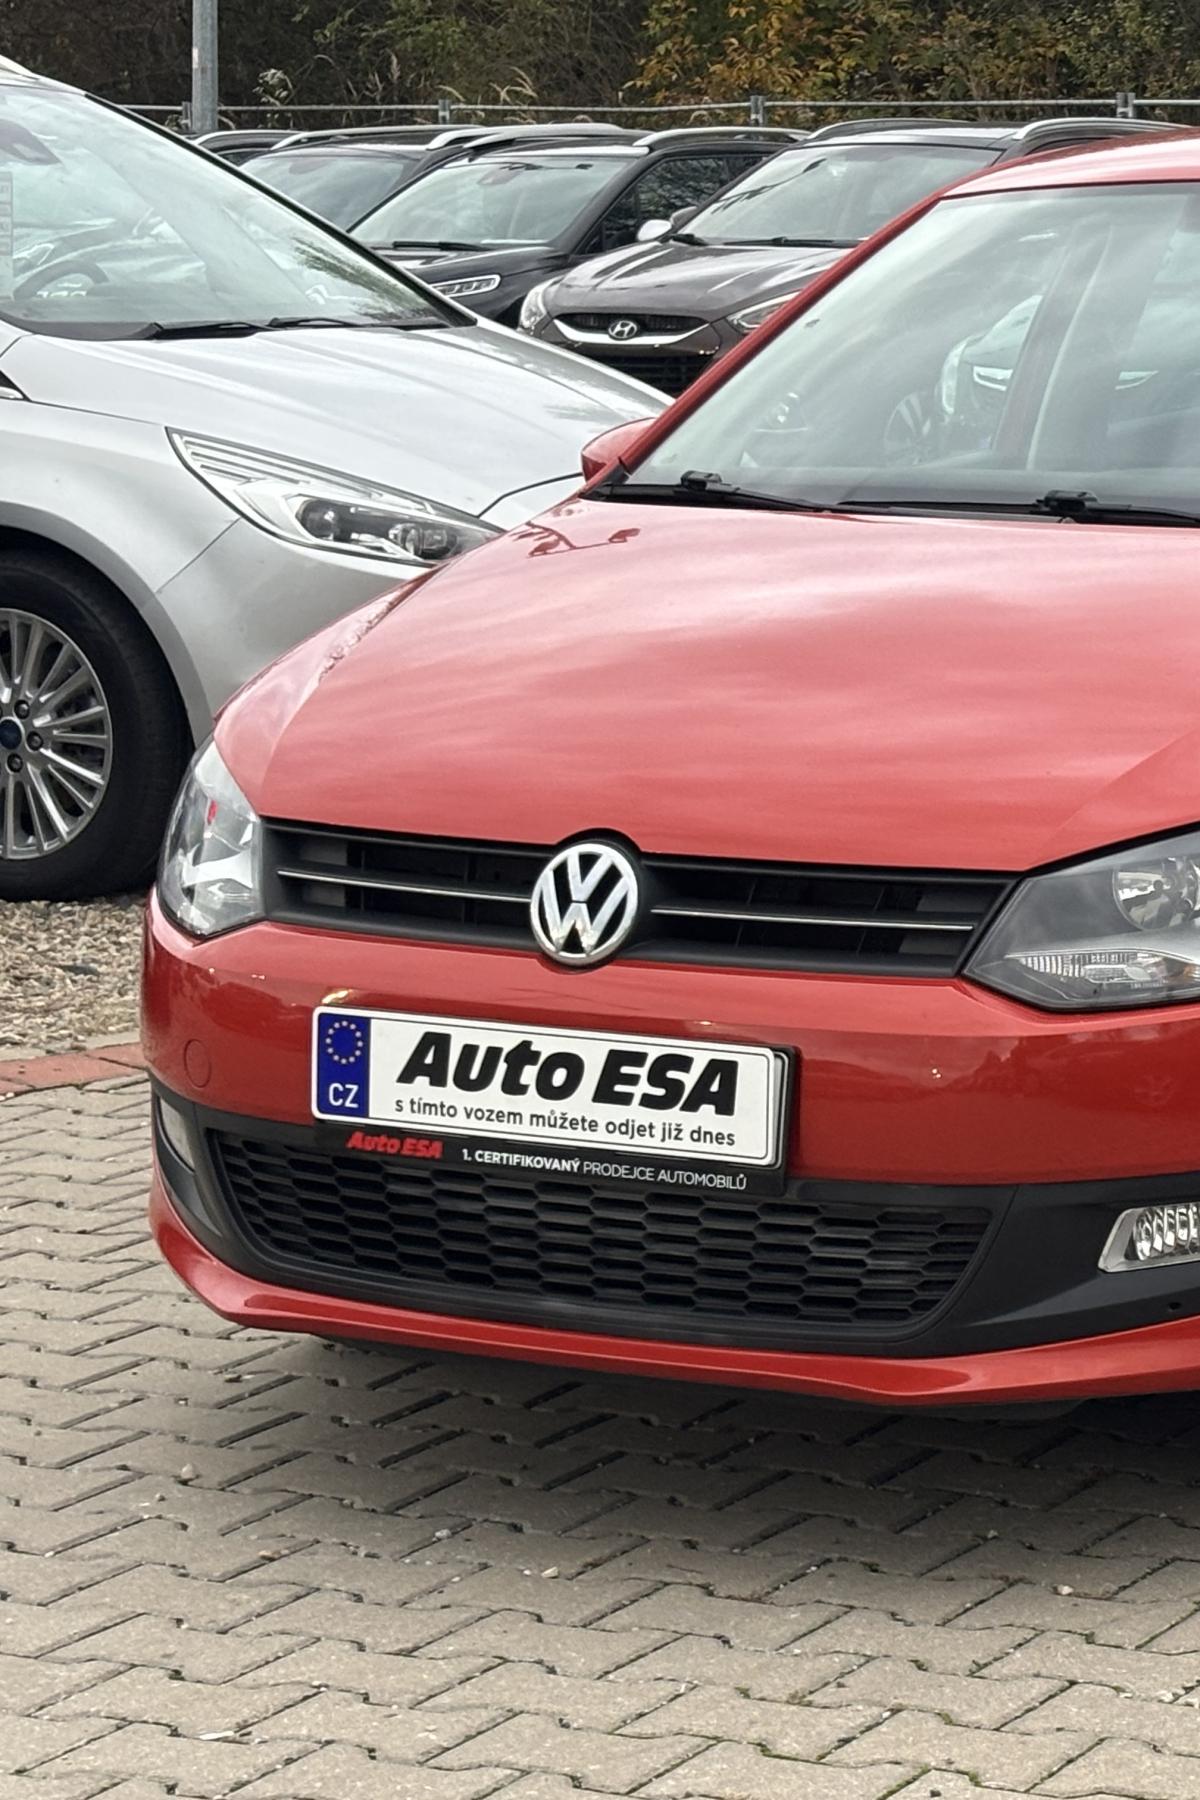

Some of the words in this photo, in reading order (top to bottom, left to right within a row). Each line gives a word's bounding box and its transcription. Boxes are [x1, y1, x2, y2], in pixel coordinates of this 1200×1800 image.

[530, 843, 638, 965] VW
[328, 1082, 359, 1109] CZ
[396, 1031, 586, 1101] Auto
[591, 1048, 739, 1117] ESA
[395, 1099, 404, 1112] s
[409, 1097, 458, 1118] tímto
[463, 1107, 523, 1125] vozem
[529, 1109, 599, 1133] můžete
[605, 1118, 655, 1139] odjet
[660, 1123, 683, 1142] již
[689, 1126, 735, 1146] dnes
[346, 1131, 400, 1153] Auto
[400, 1138, 443, 1158] ESA
[462, 1149, 472, 1161] 1.
[474, 1150, 580, 1173] CERTIFIKOVANÝ
[583, 1161, 655, 1181] PRODEJCE
[657, 1169, 747, 1190] AUTOMOBILŮ
